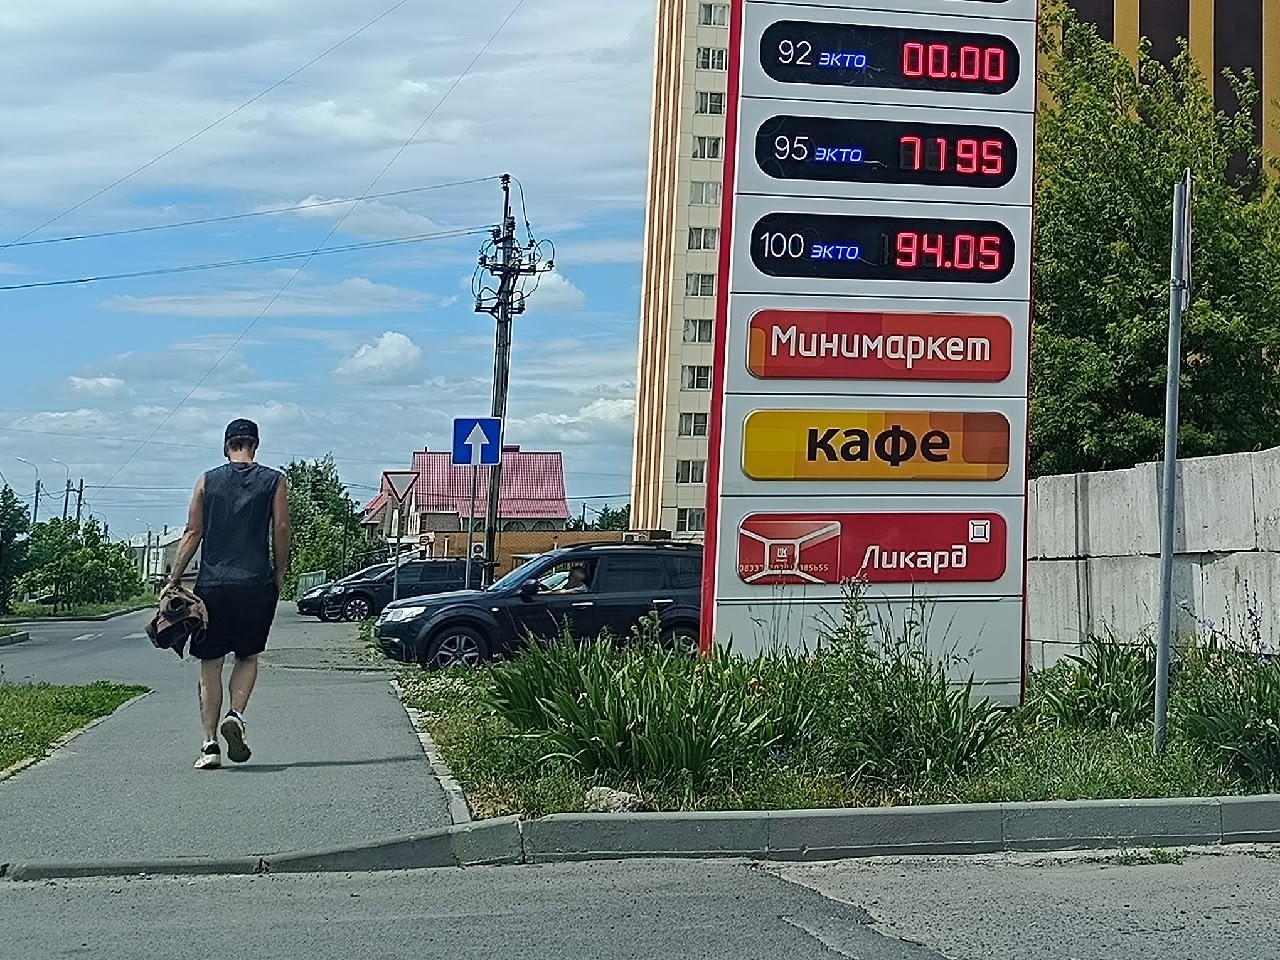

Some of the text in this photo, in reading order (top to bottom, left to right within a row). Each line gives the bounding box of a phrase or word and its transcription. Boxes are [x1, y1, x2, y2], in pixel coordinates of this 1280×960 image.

[778, 40, 1004, 81] 92 ЭКТО 00.00
[774, 135, 809, 160] 95
[815, 147, 862, 162] ЭКТО
[760, 232, 1000, 270] 100 ЭКТО 94.05
[771, 325, 990, 369] Минимаркет
[807, 424, 950, 467] кафе
[861, 544, 967, 573] Ликард
